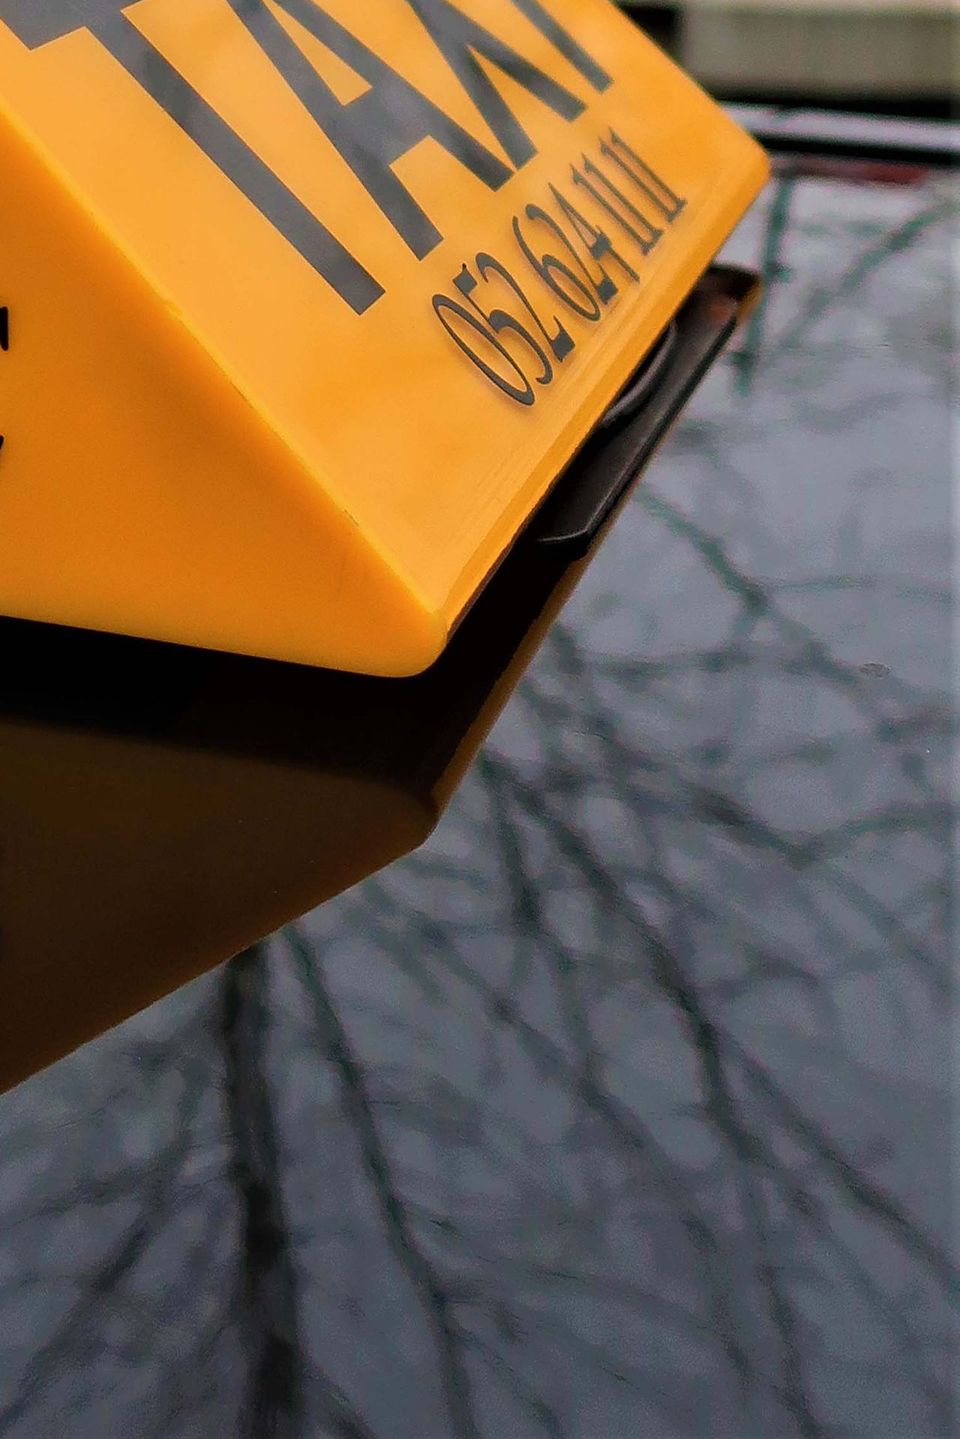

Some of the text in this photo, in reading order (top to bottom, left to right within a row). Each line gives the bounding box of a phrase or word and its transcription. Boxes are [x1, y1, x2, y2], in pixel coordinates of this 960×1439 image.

[432, 125, 688, 406] 052 624 11 11
